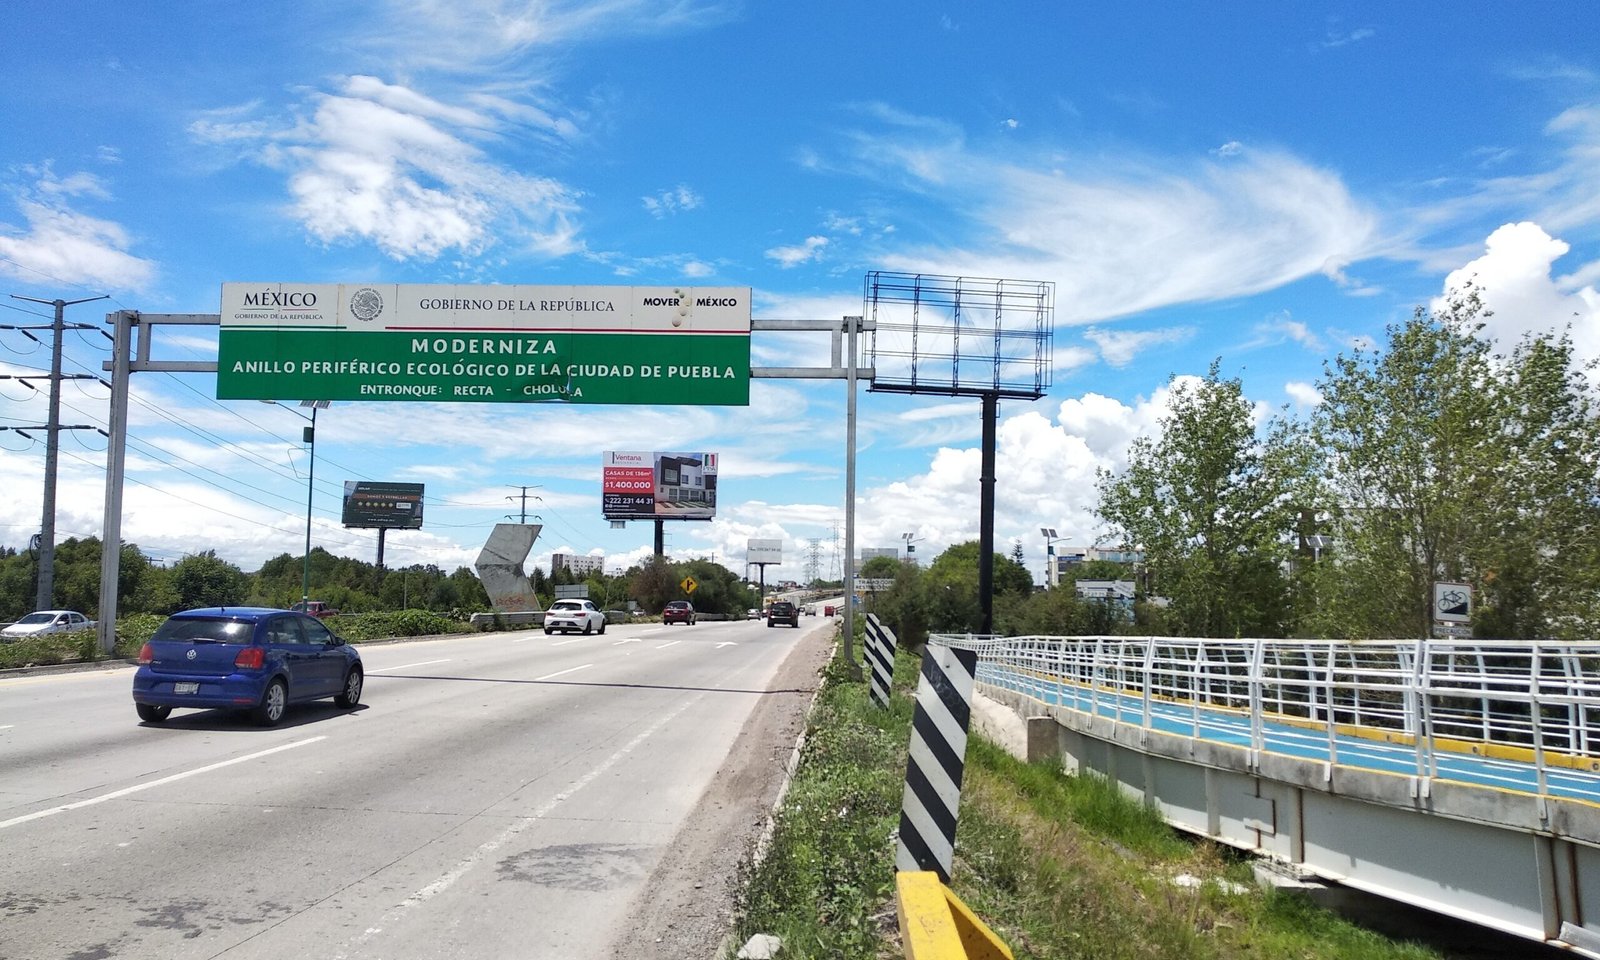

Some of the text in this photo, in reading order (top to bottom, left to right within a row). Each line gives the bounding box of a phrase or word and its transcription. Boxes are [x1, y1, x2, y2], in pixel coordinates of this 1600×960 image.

[243, 288, 317, 307] MÉXICO
[420, 296, 615, 312] GOBIERNO DE LA REPÚBLICA
[643, 295, 737, 307] MOVER MÉXICO
[289, 312, 323, 320] REPÚBLICA
[411, 338, 557, 355] MODERNIZA
[232, 358, 736, 379] ANILLO PERIFÉRICO ECOLÓGICO DE LA CIUDAD DE PUEBLA
[360, 384, 442, 397] ENTRONQUE:
[454, 385, 494, 396] RECTA
[523, 383, 583, 397] CHOLUA
